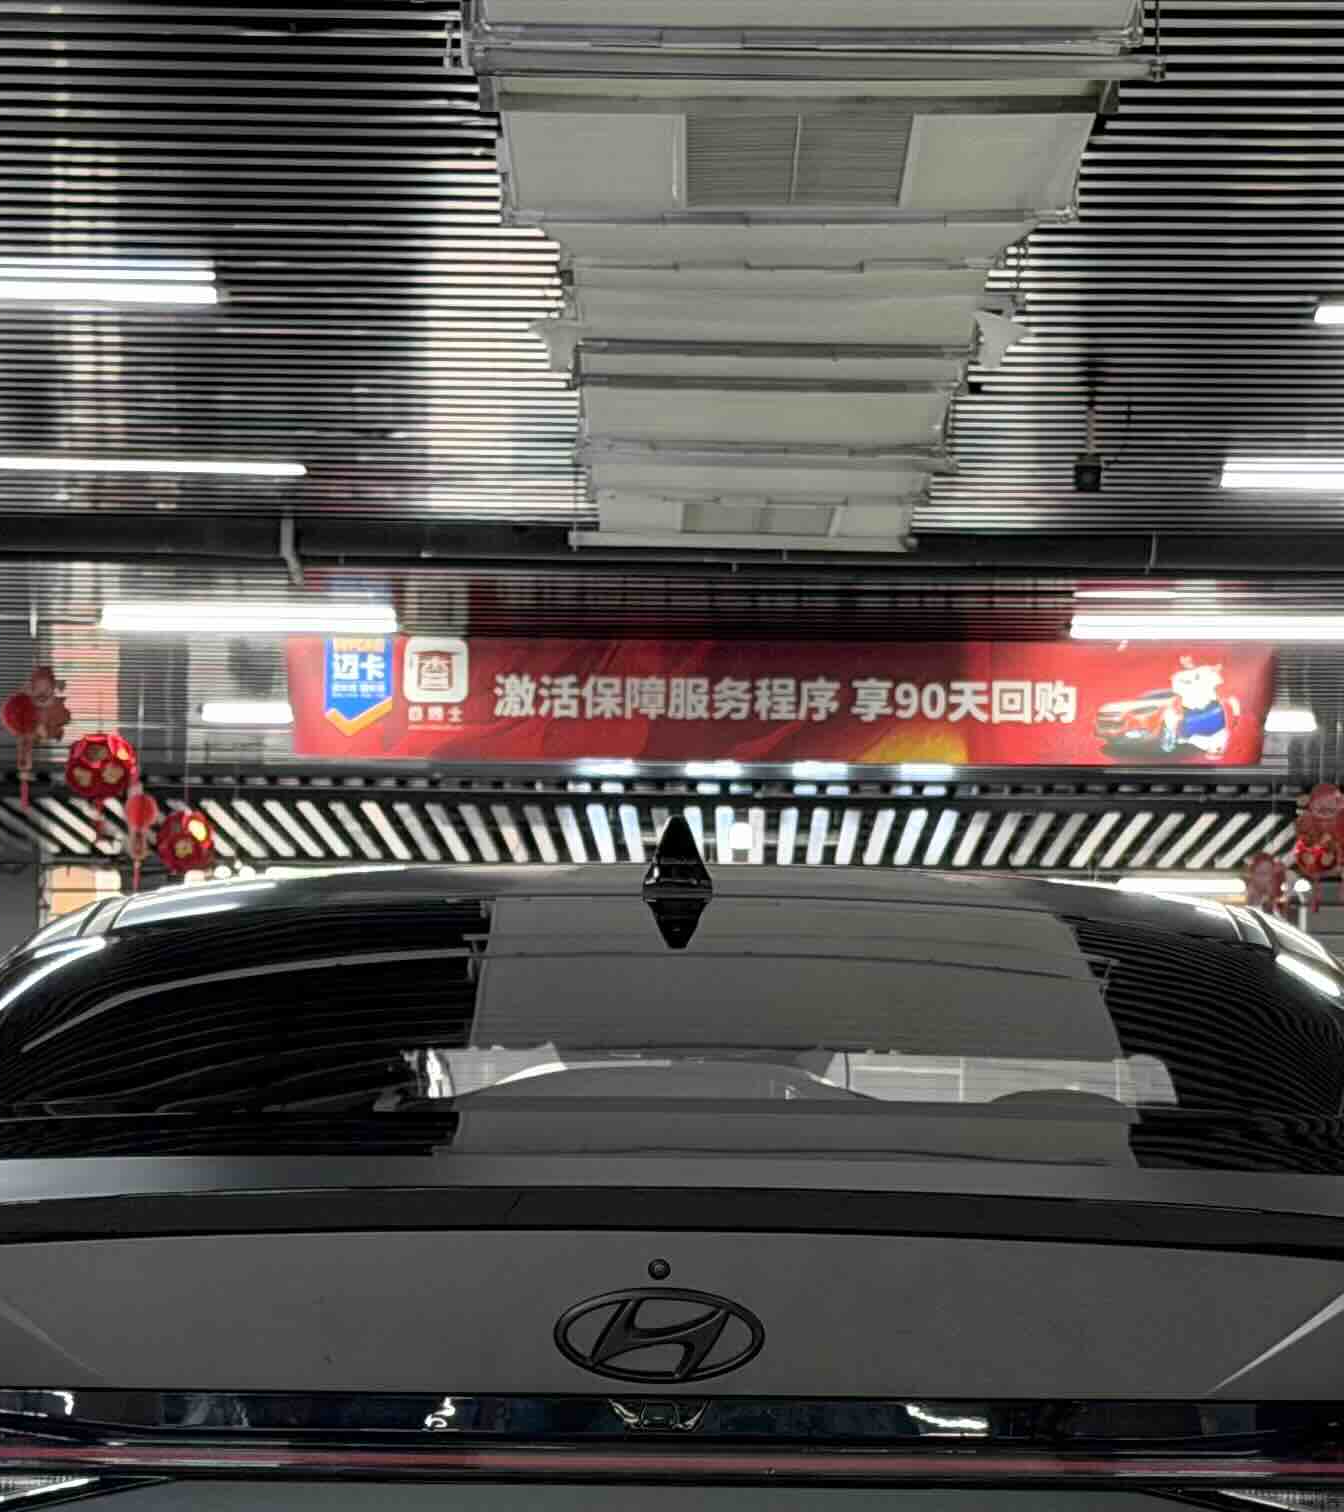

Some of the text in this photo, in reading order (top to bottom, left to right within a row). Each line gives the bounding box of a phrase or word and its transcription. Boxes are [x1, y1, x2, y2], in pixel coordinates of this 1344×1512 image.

[493, 674, 1077, 724] 激活保障服务程序 享90天回购
